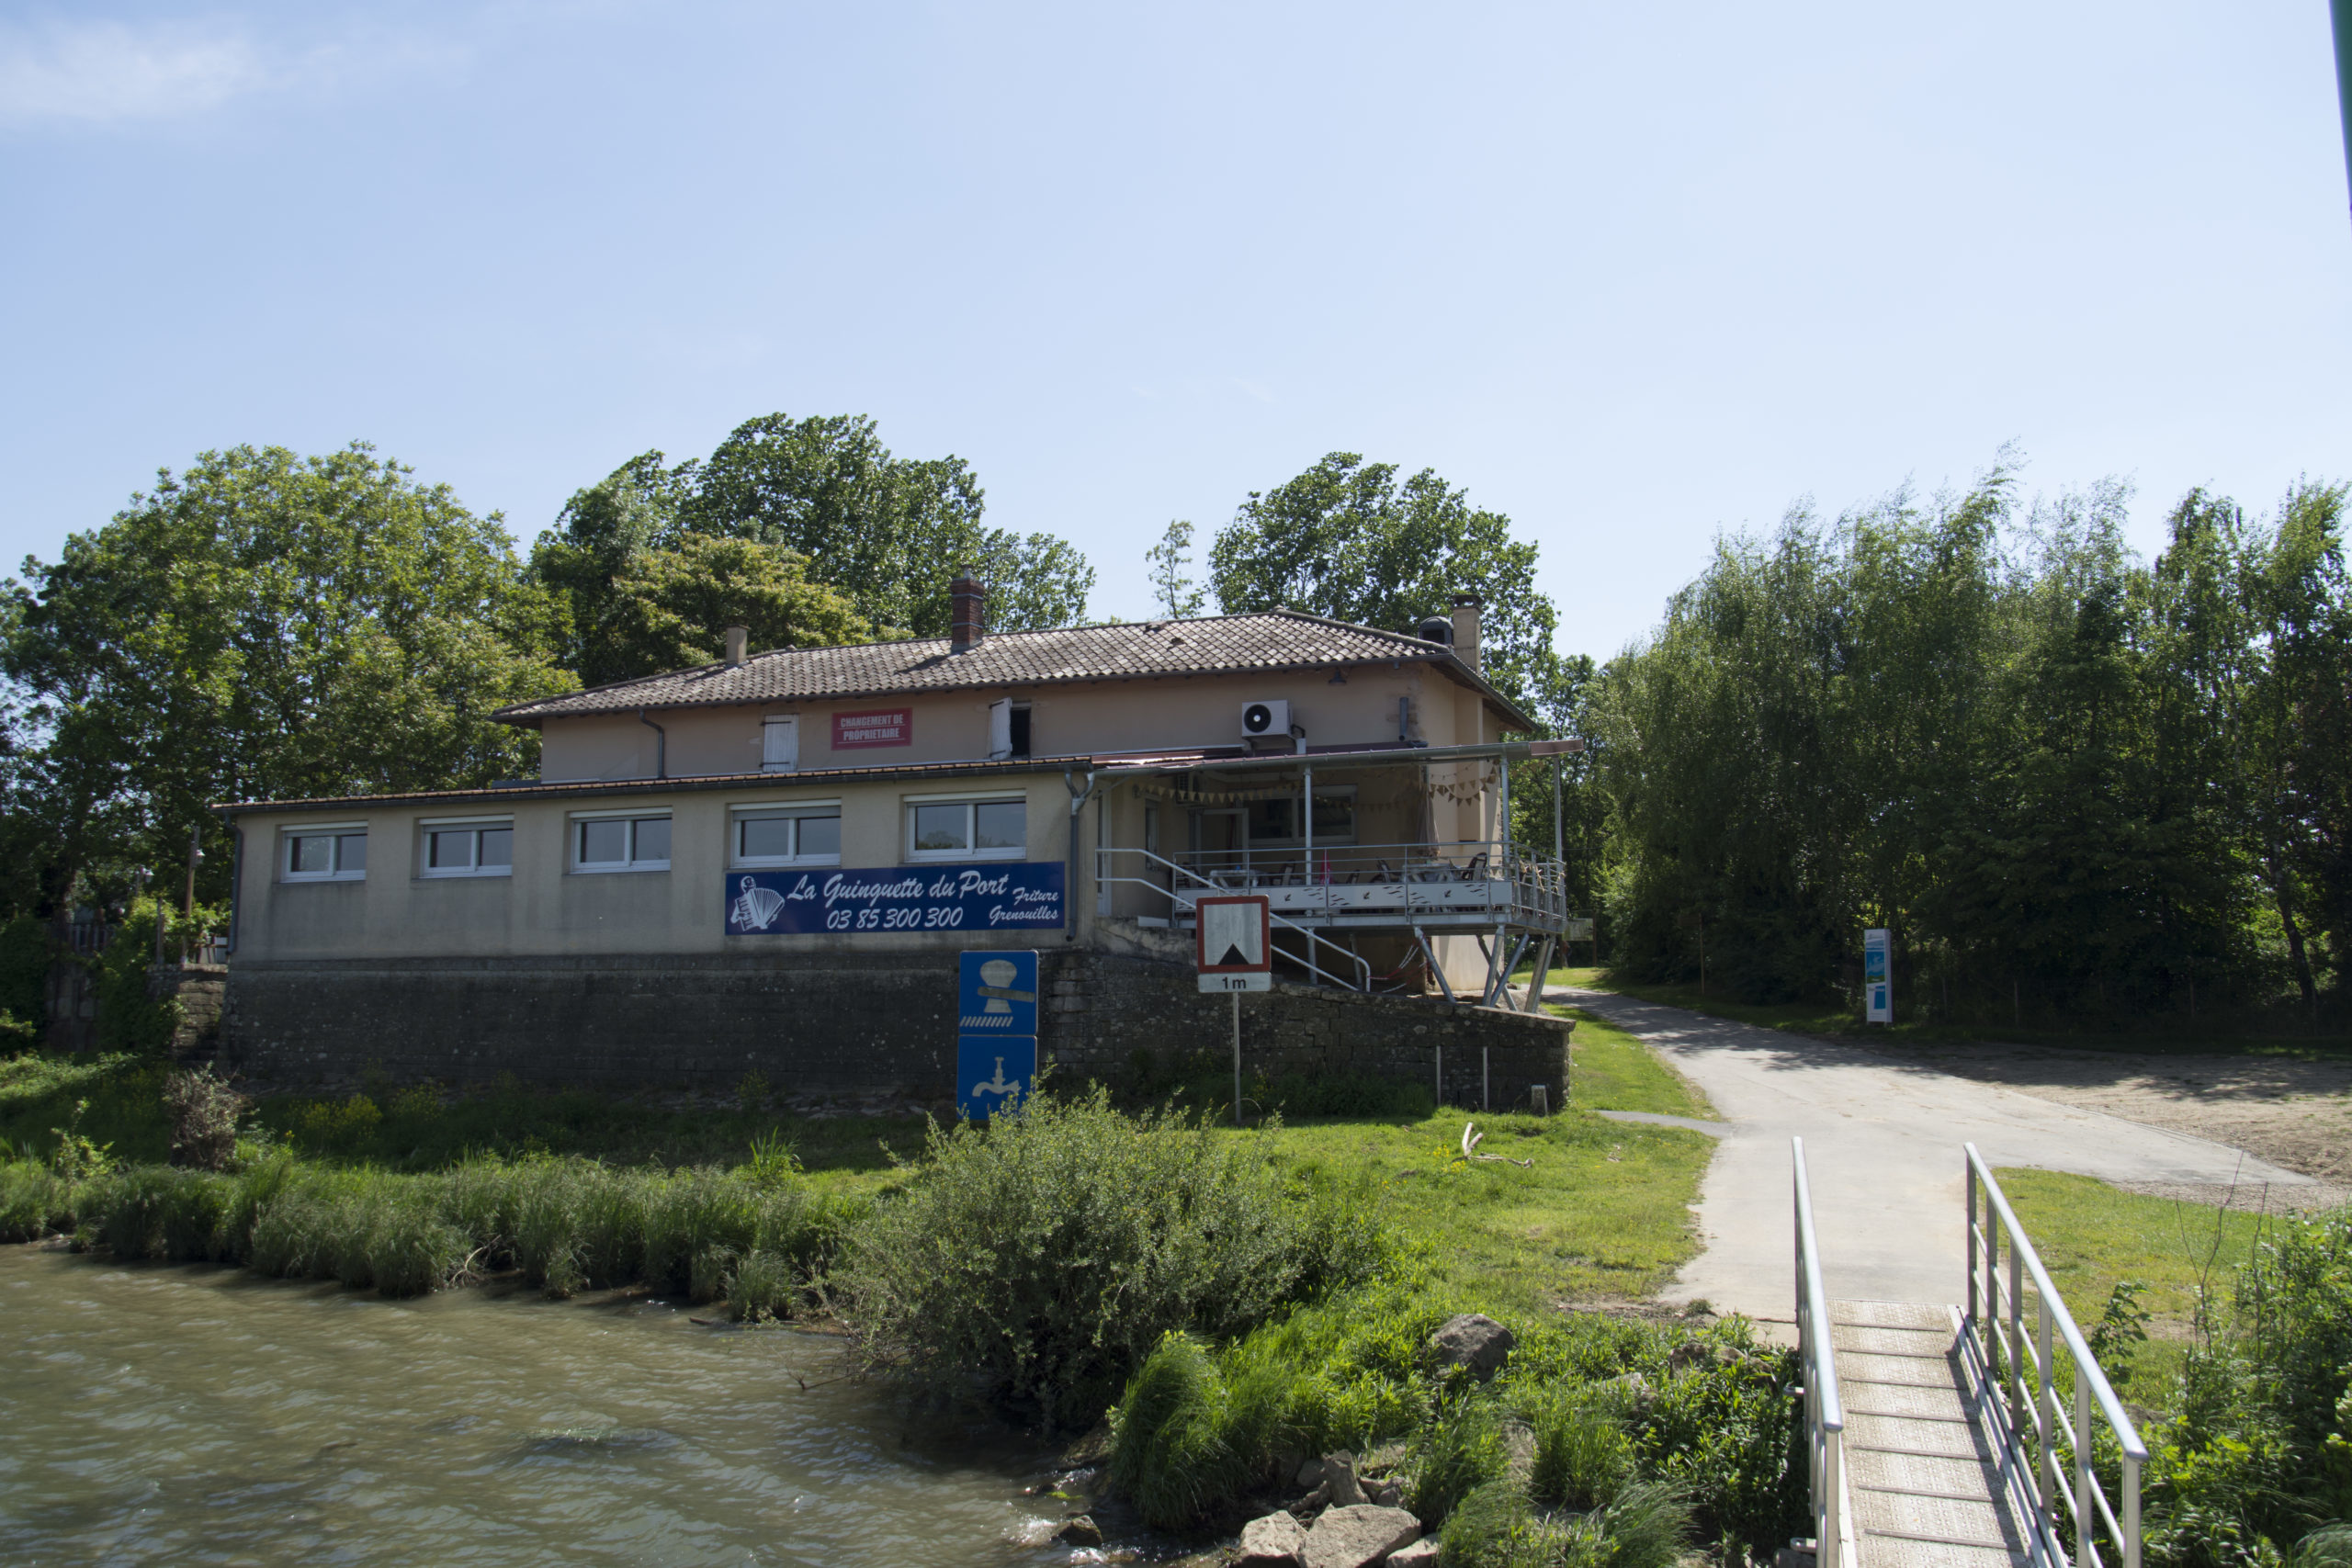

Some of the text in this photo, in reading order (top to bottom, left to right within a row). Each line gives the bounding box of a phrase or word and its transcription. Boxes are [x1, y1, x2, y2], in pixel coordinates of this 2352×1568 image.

[840, 714, 904, 728] CHANGEMENT DE
[842, 728, 899, 741] PROPRIETAIRE
[786, 870, 1010, 908] La Guinguette du Port
[1012, 886, 1059, 906] Friture
[827, 906, 964, 930] 03 85 300 300
[989, 905, 1059, 926] Grenouilles
